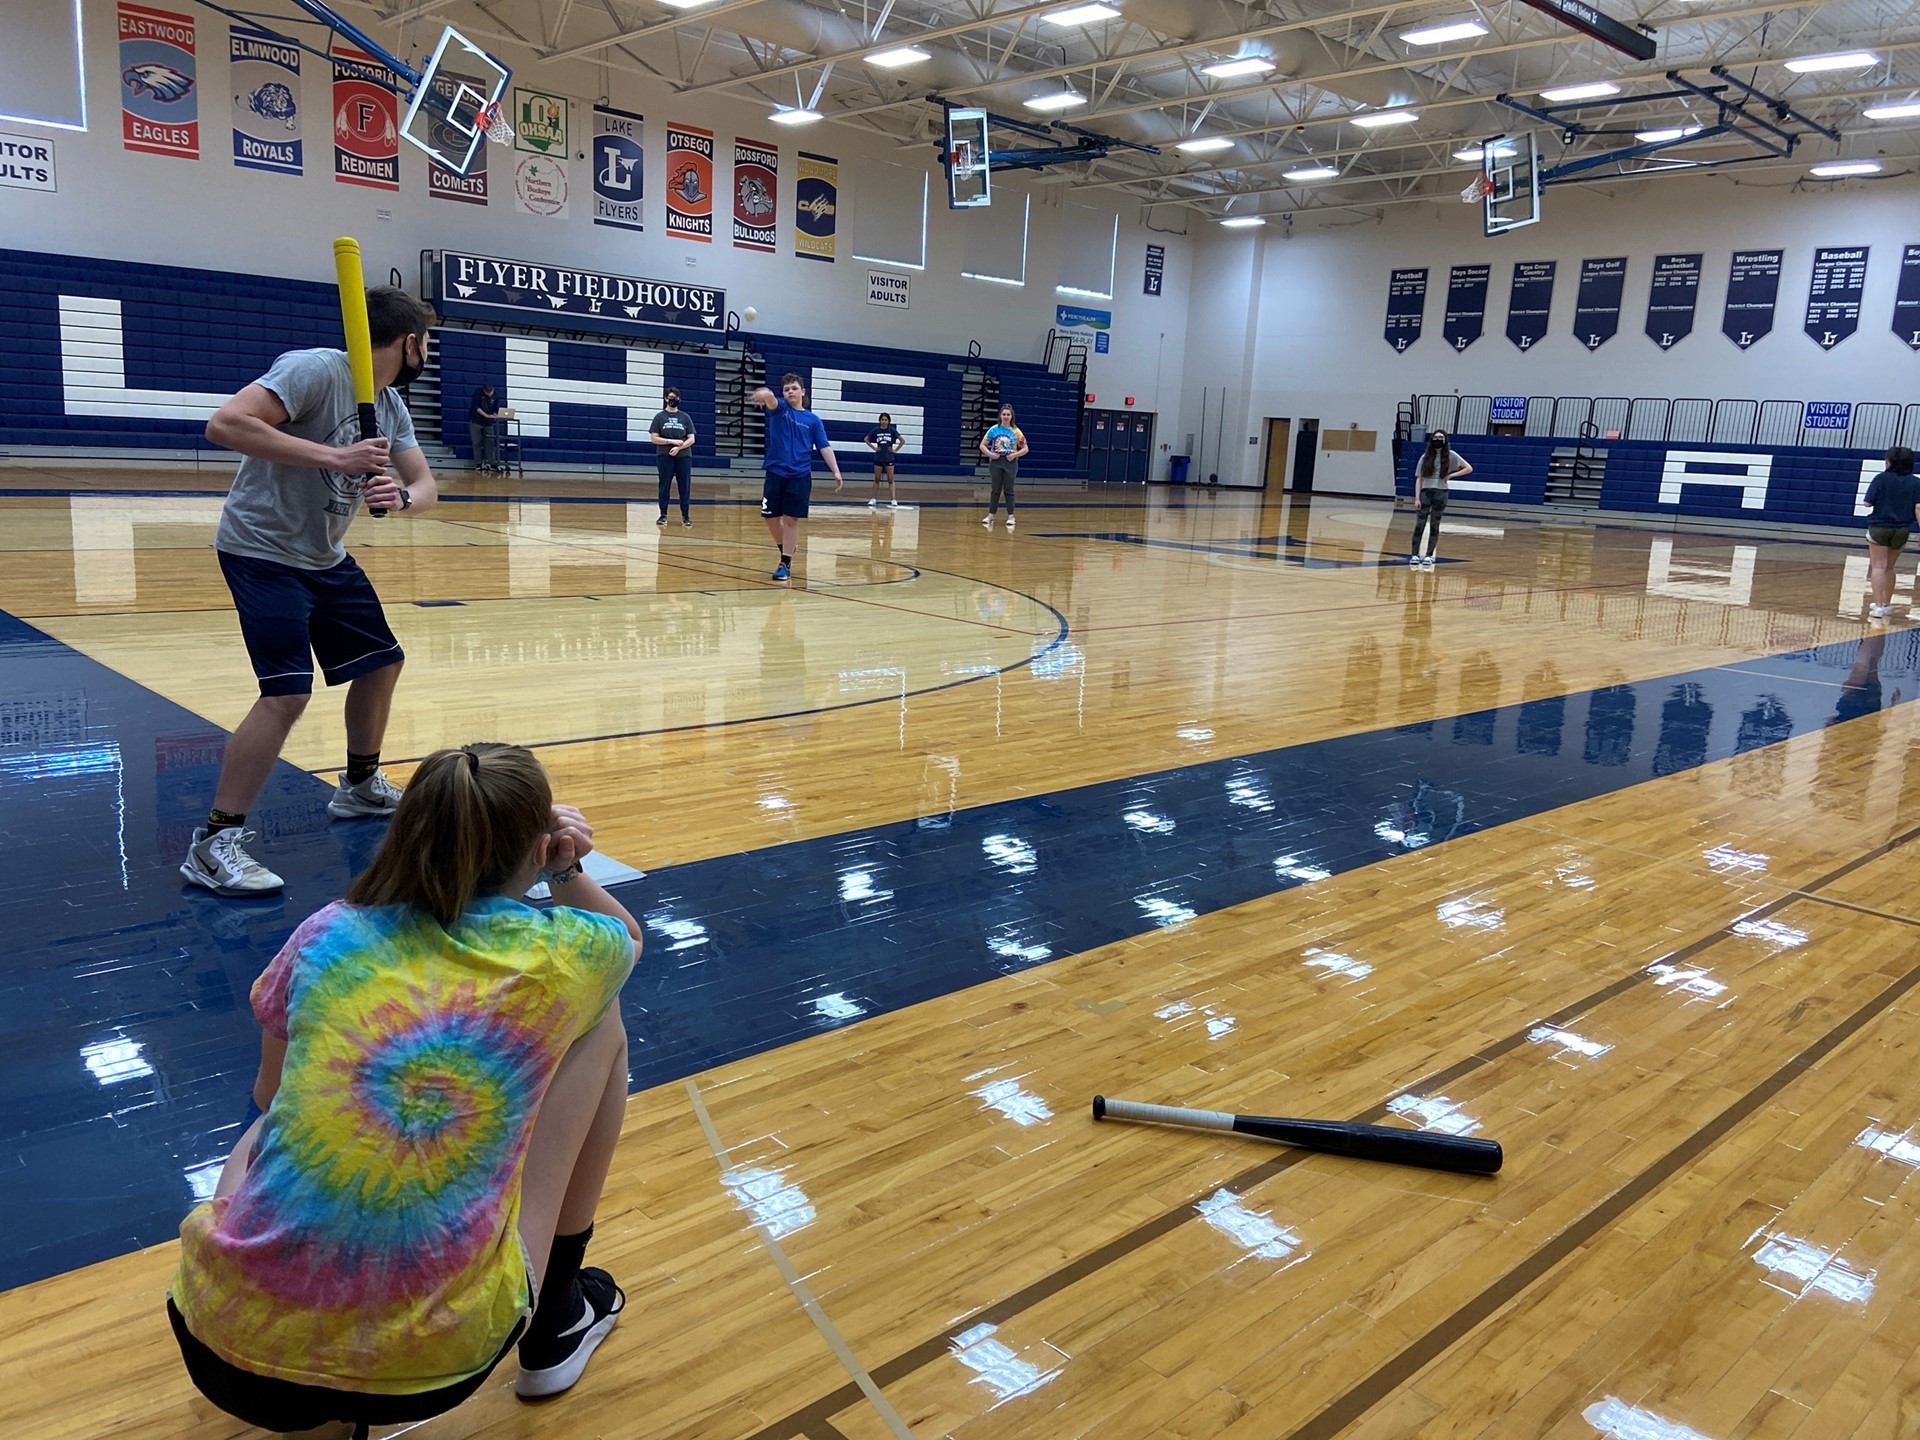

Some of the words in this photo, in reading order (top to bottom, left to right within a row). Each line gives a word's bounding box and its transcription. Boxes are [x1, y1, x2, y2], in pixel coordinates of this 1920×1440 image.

[119, 17, 194, 46] EASTWOOD
[231, 40, 299, 67] ELMWOOD
[334, 62, 395, 84] FOSTORIA
[357, 102, 376, 132] F
[605, 117, 633, 137] LAKE
[132, 121, 190, 145] EAGLES
[519, 121, 564, 144] OHSAA
[242, 138, 294, 162] ROYALS
[670, 133, 710, 155] OTSEGO
[341, 154, 393, 179] REDMEN
[604, 146, 632, 191] L
[735, 148, 777, 169] ROSSFORD
[525, 175, 552, 187] Northern
[799, 162, 837, 180] WOODMORE
[433, 170, 484, 193] COMETS
[527, 185, 551, 196] Buckeye
[528, 193, 560, 206] Conference
[599, 200, 638, 221] FLYERS
[669, 212, 711, 233] KNIGHTS
[734, 223, 775, 243] BULLDOGS
[799, 238, 832, 251] WILDCATS
[1736, 255, 1778, 263] Wrestling
[1821, 251, 1863, 260] Baseball
[458, 257, 549, 292] FLYER
[556, 271, 716, 313] FIELDHOUSE
[870, 275, 908, 290] VISITOR
[1396, 272, 1423, 280] Football
[589, 298, 602, 313] L
[870, 290, 907, 304] ADULTS
[1824, 331, 1838, 346] L
[1495, 398, 1525, 408] VISITOR
[1810, 403, 1849, 415] VISITOR
[1492, 409, 1525, 419] STUDENT
[1805, 416, 1849, 428] STUDENT
